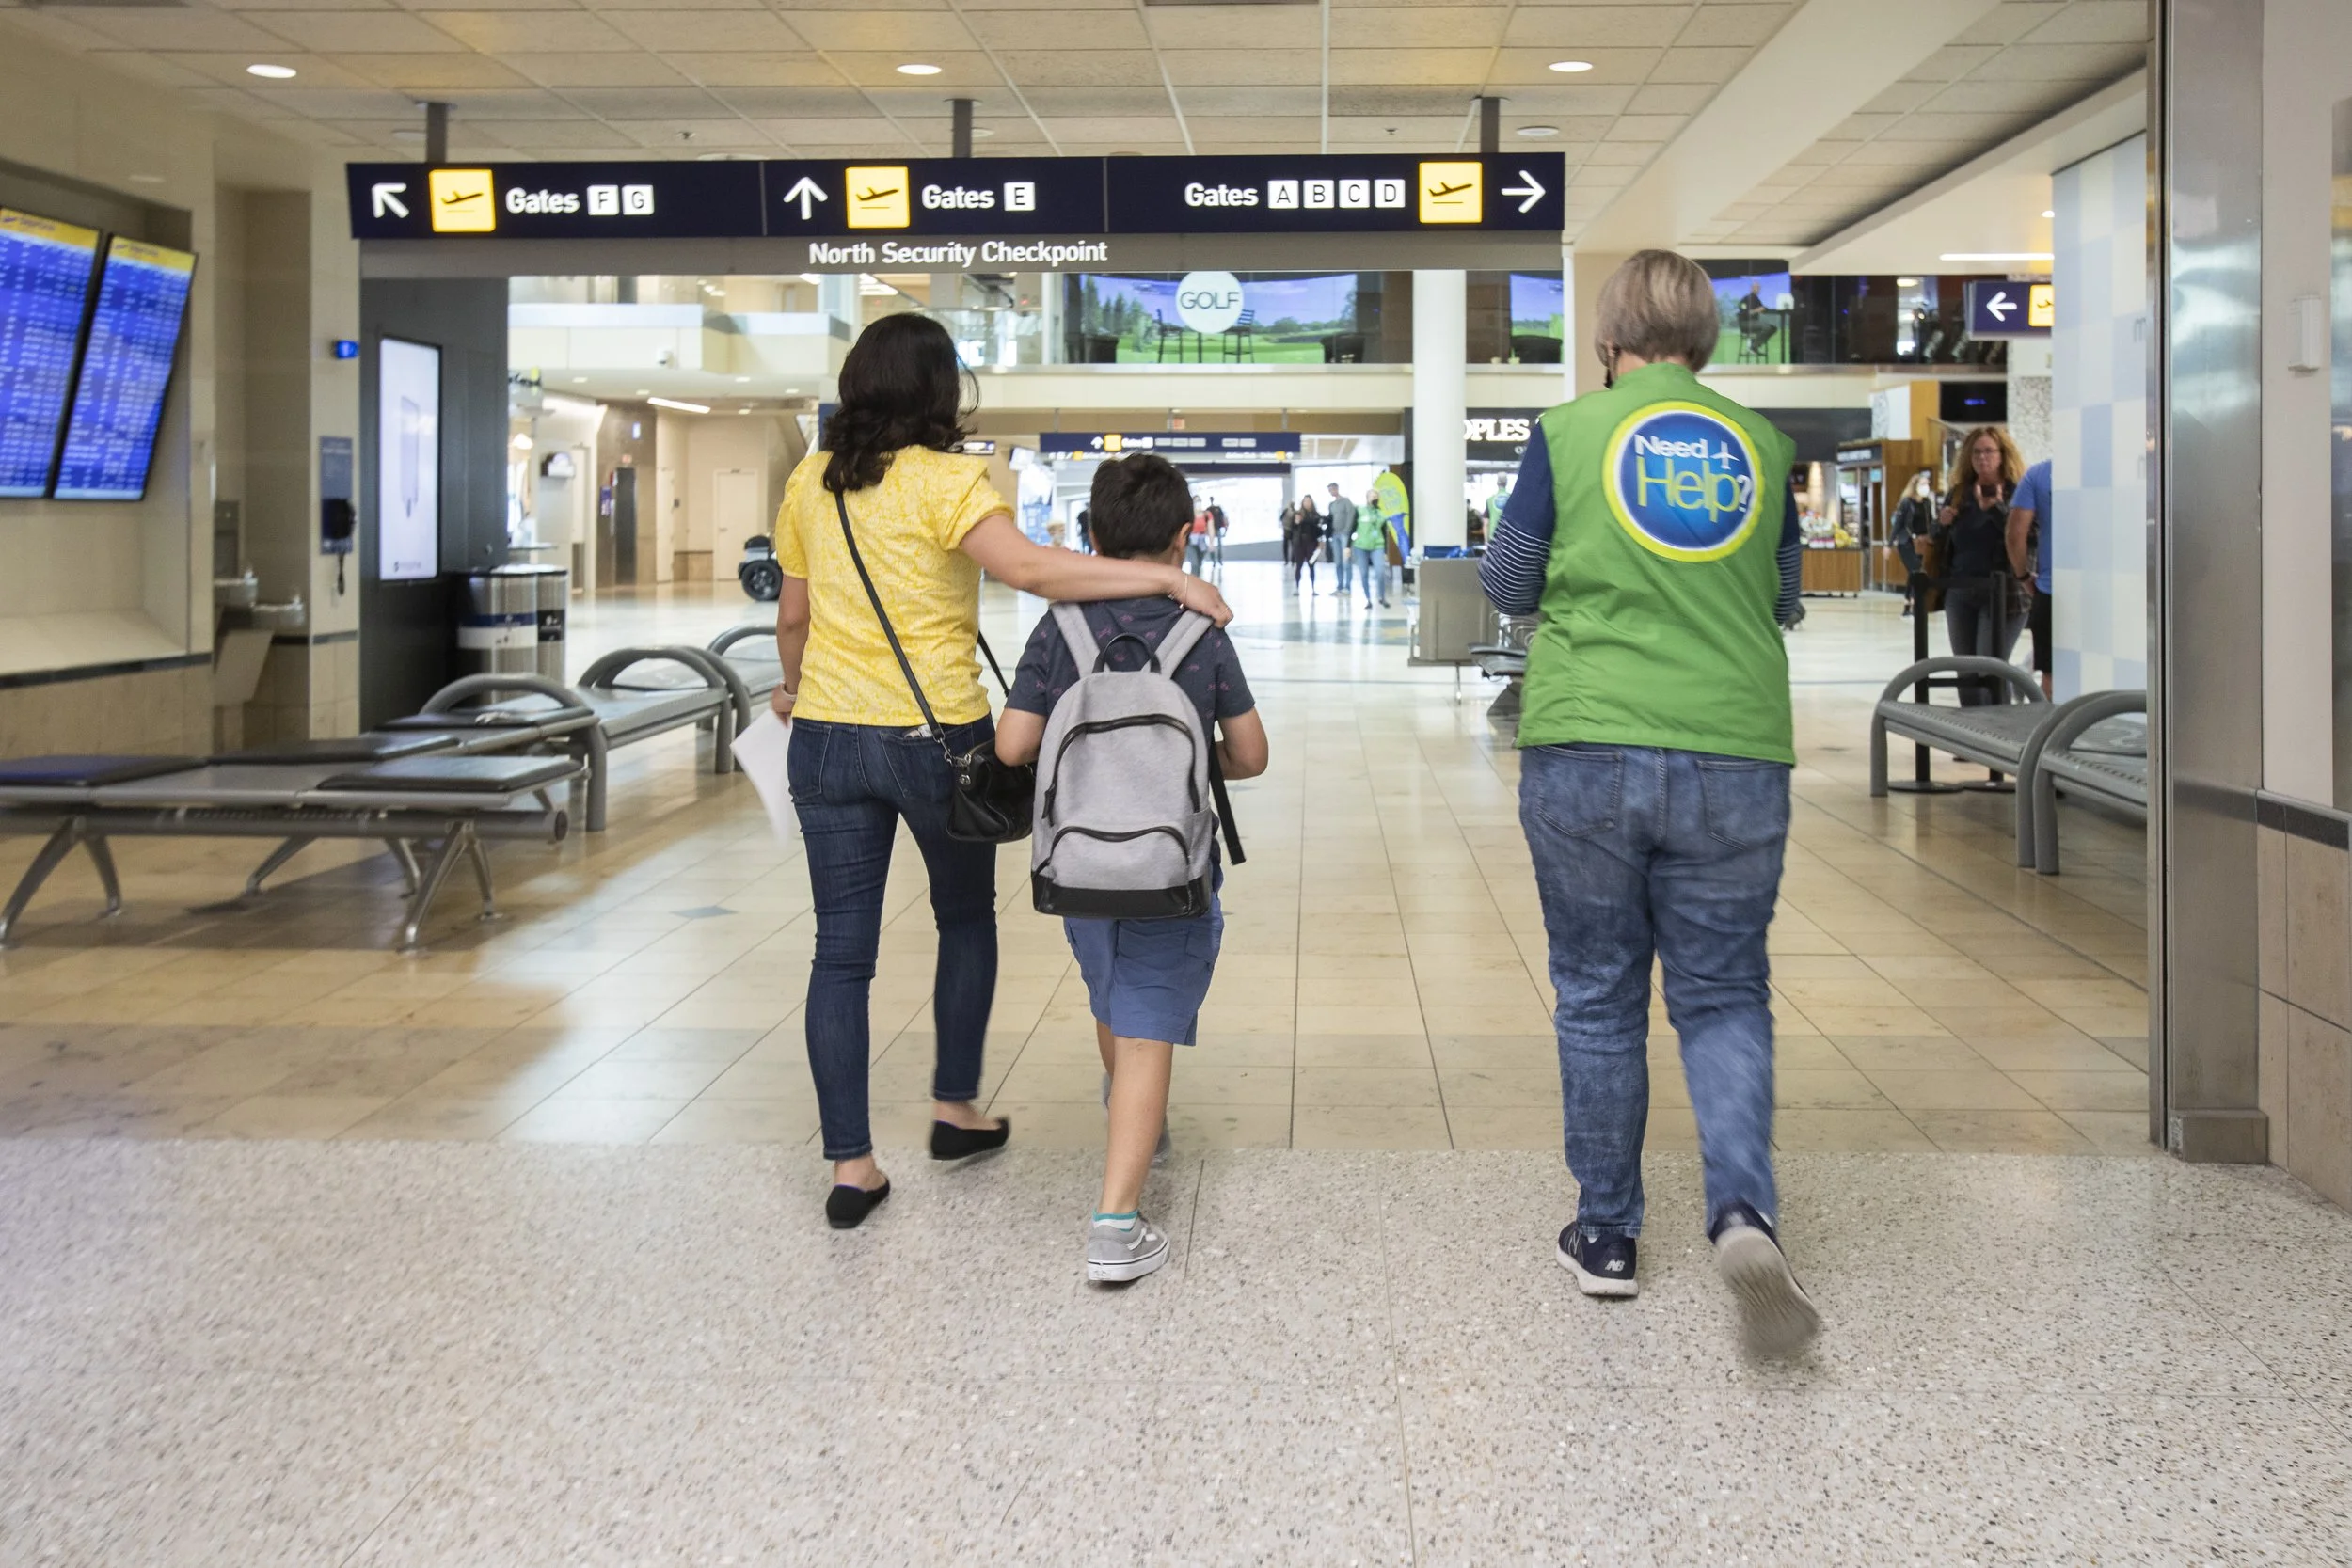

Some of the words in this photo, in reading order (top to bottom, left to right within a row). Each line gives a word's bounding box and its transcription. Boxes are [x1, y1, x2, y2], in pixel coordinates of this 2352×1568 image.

[505, 187, 580, 214] Gates
[631, 190, 645, 209] G
[922, 184, 995, 209] Gates
[1014, 186, 1026, 206] E
[1184, 182, 1259, 206] Gates
[1276, 184, 1292, 203] A
[1312, 184, 1326, 203] B
[1347, 183, 1361, 203] C
[1383, 183, 1397, 203] D
[809, 242, 876, 264] North
[882, 241, 977, 268] Security
[981, 240, 1108, 267] Checkpoint
[1180, 291, 1240, 310] GOLF
[1633, 434, 1709, 459] Need
[1635, 455, 1752, 523] Help?
